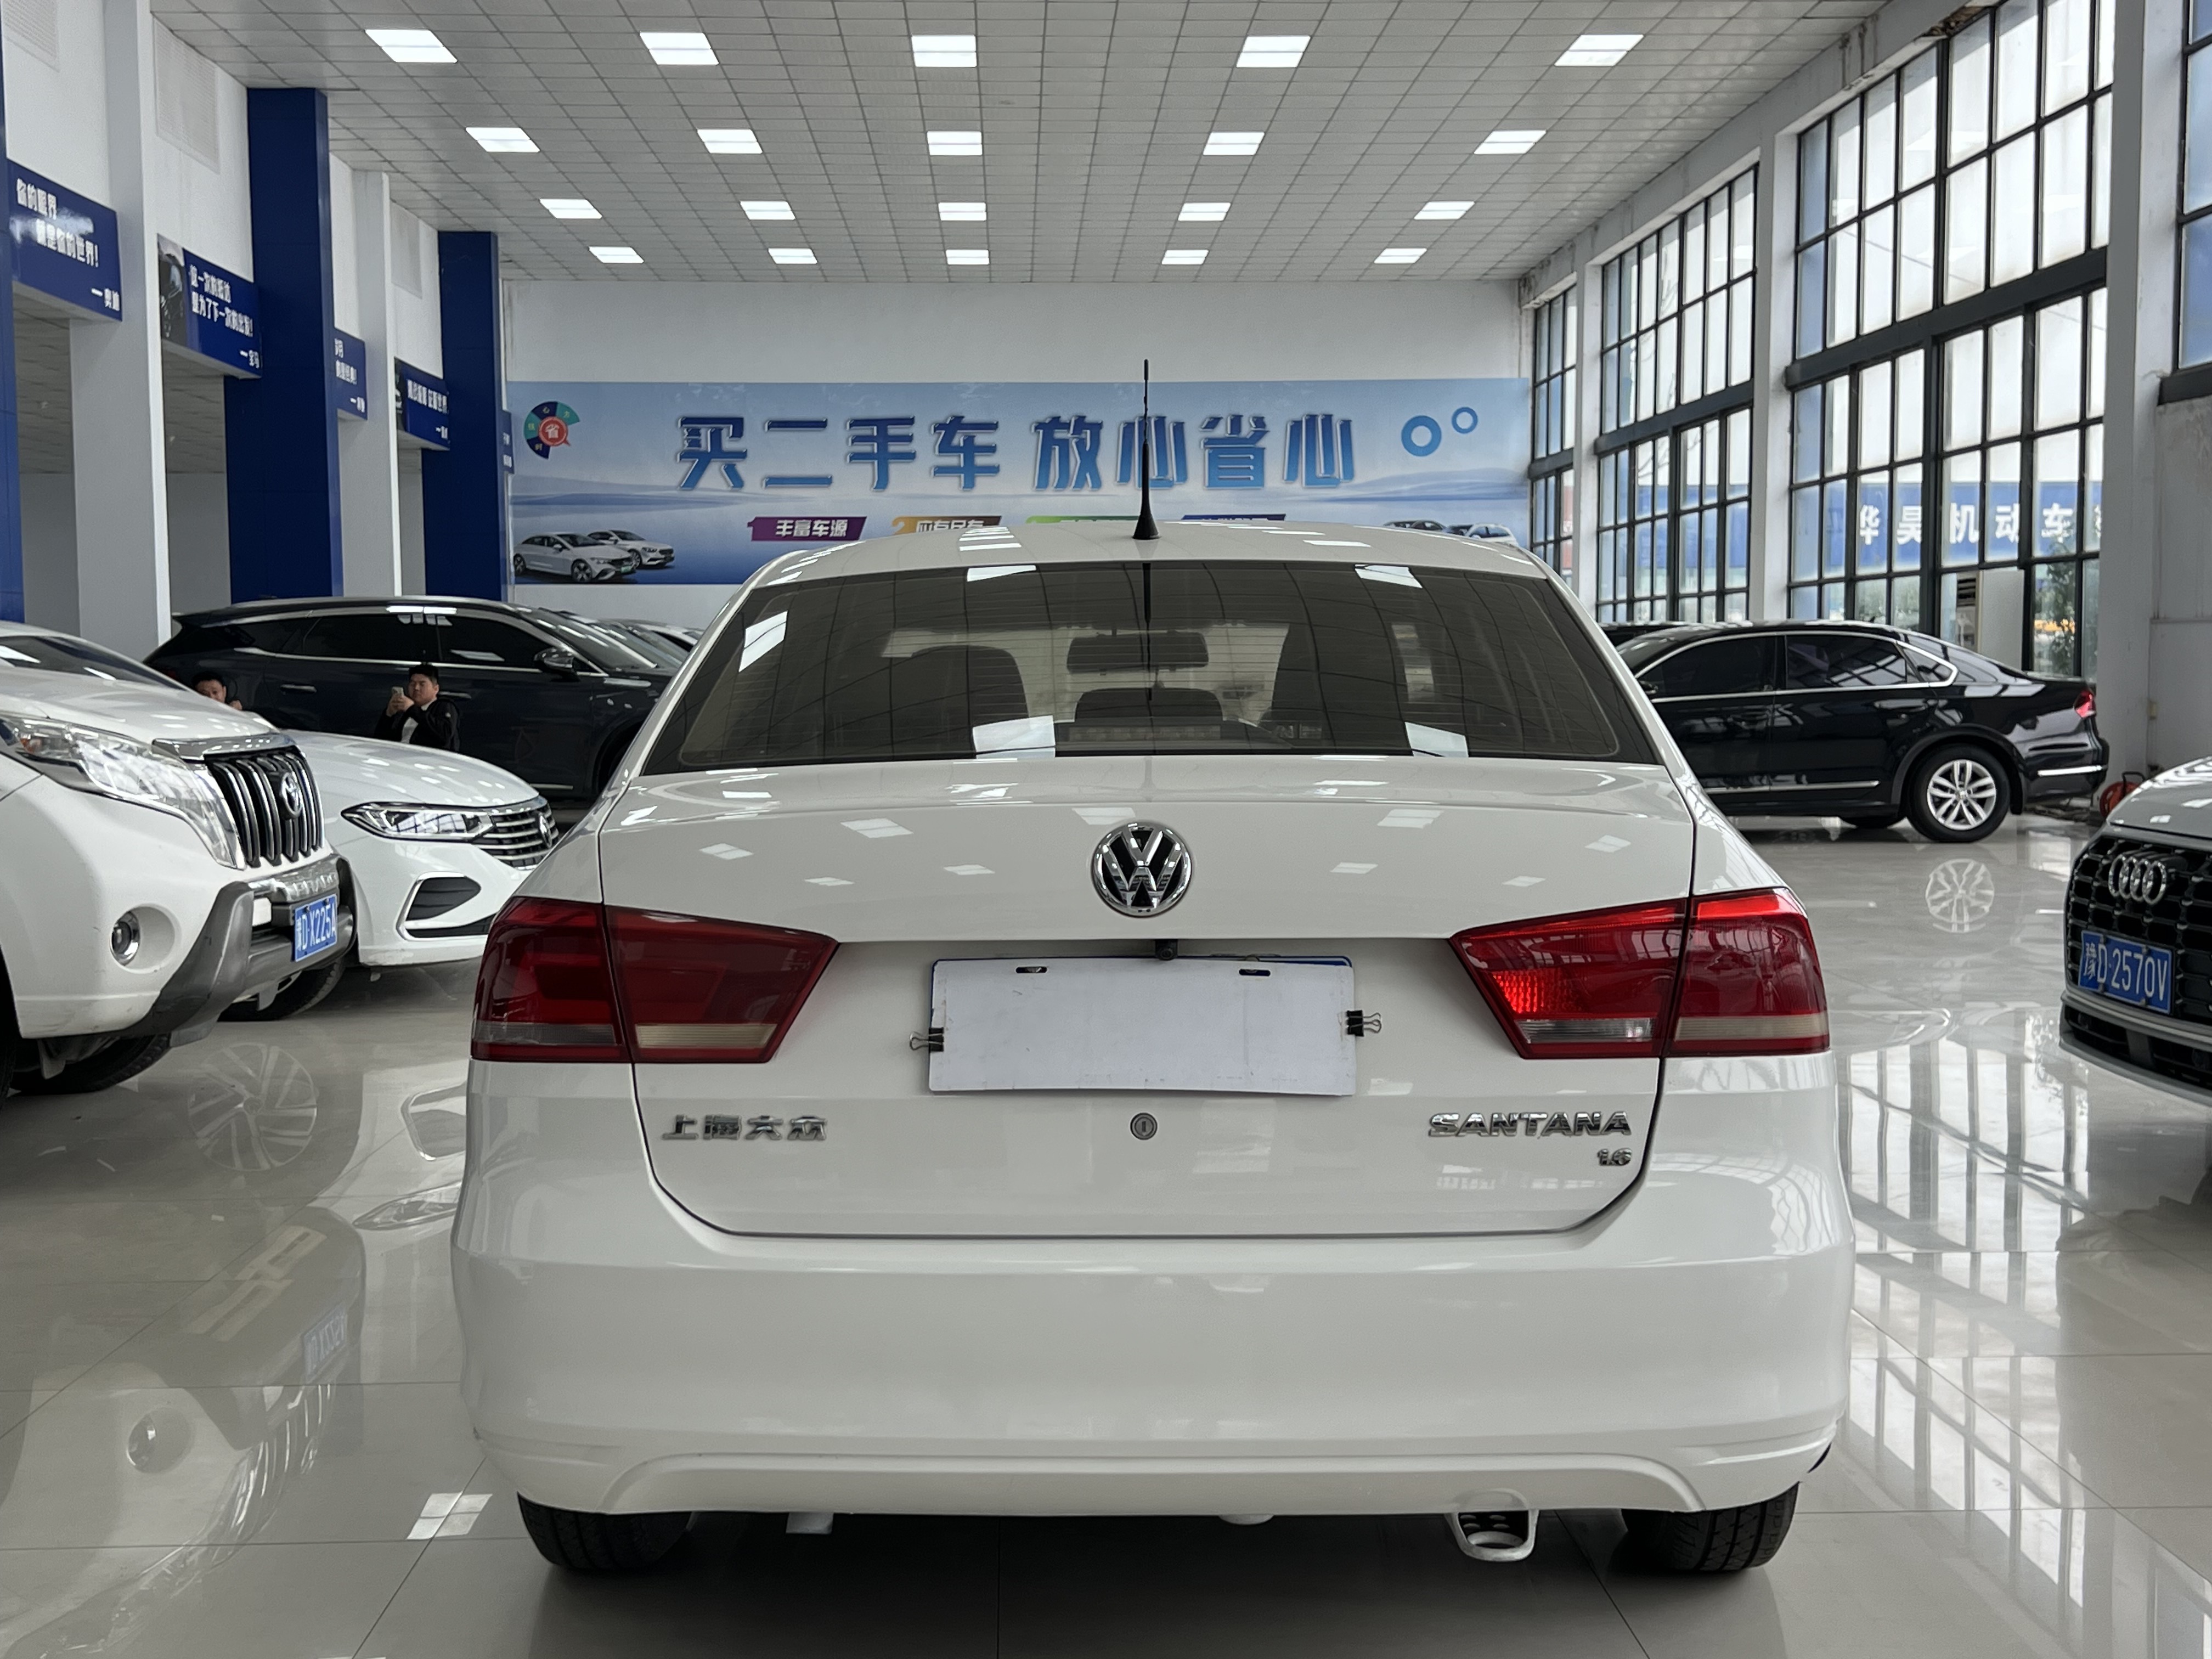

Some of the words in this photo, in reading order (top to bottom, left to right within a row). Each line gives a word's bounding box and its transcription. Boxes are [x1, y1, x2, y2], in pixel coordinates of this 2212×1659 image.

[678, 415, 1001, 491] 买二手车
[1031, 413, 1356, 490] 放心省心
[775, 520, 848, 538] 丰富车源
[1860, 502, 2101, 544] 华昊机动车
[661, 1114, 827, 1141] 上海大众
[1428, 1111, 1633, 1137] SANTANA
[1597, 1148, 1633, 1166] 1.6
